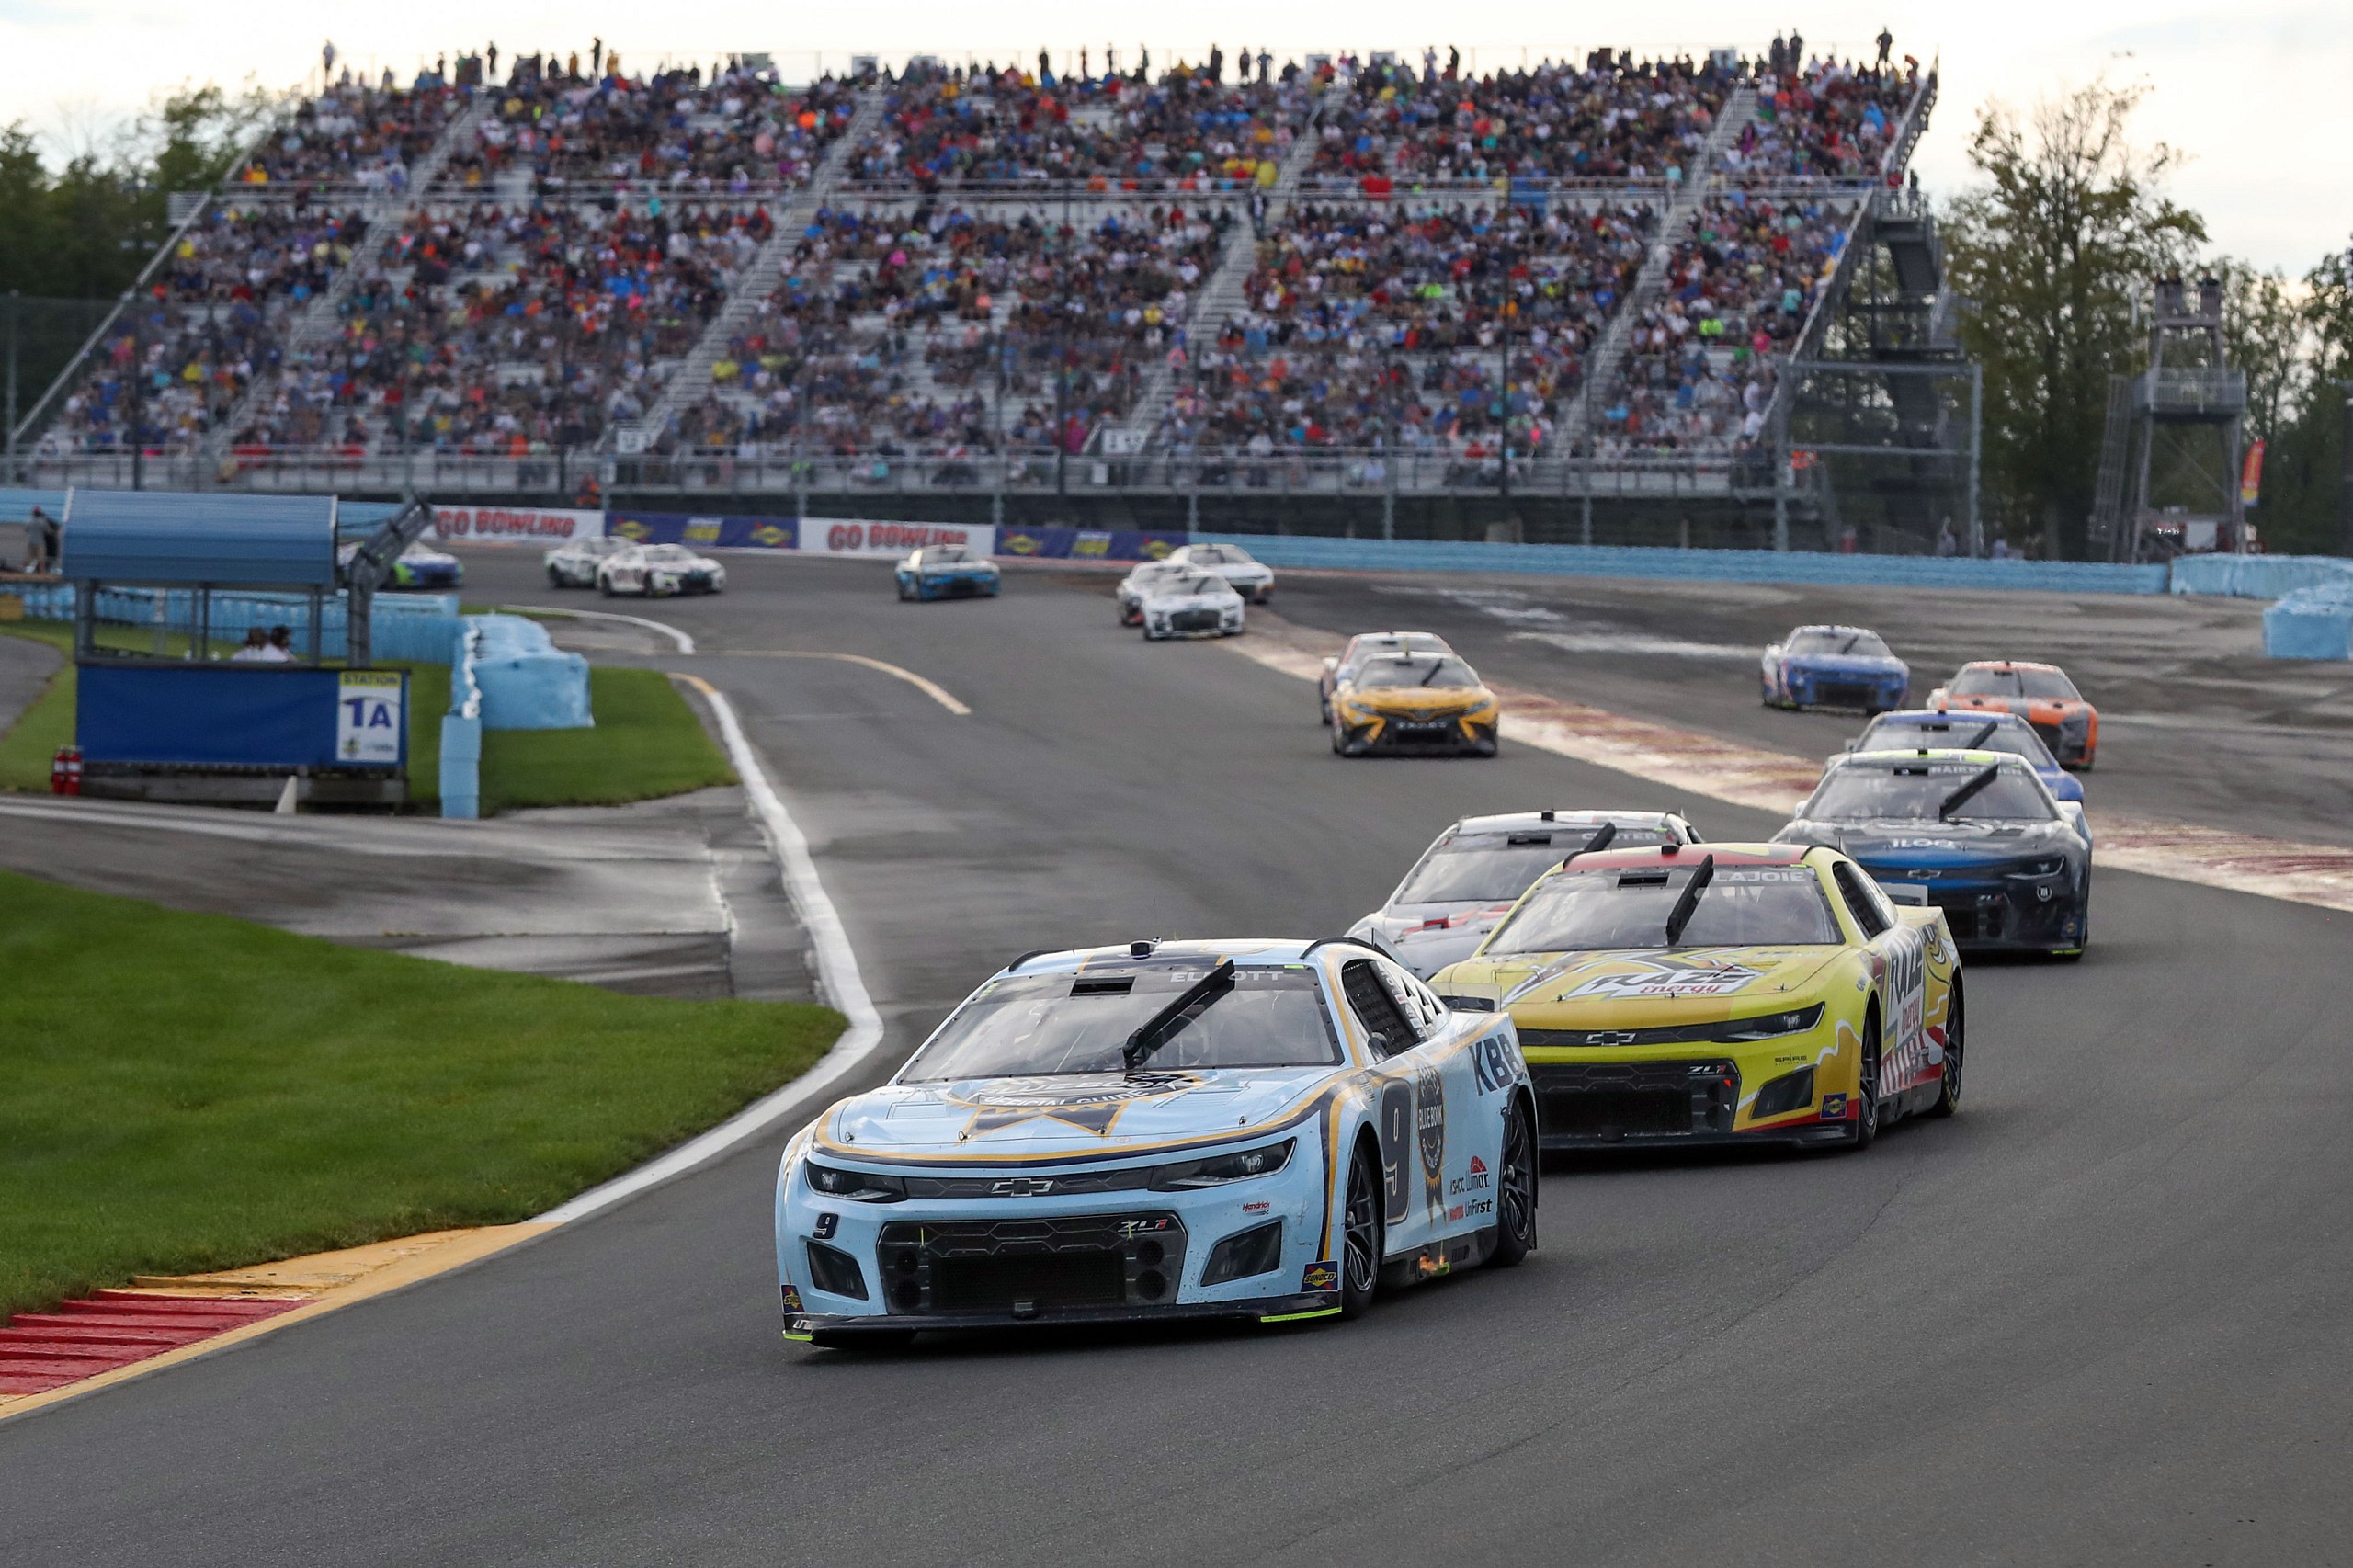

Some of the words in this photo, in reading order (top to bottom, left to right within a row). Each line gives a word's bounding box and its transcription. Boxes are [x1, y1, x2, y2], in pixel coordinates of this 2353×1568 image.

[435, 510, 470, 537] GO
[475, 510, 576, 538] BOWLING
[828, 523, 863, 551] GO
[346, 697, 392, 728] 1A
[1712, 870, 1806, 883] LAJOIE
[1169, 971, 1285, 983] ELOTT
[813, 1211, 840, 1241] 9
[1304, 1272, 1336, 1283] SUNOCO
